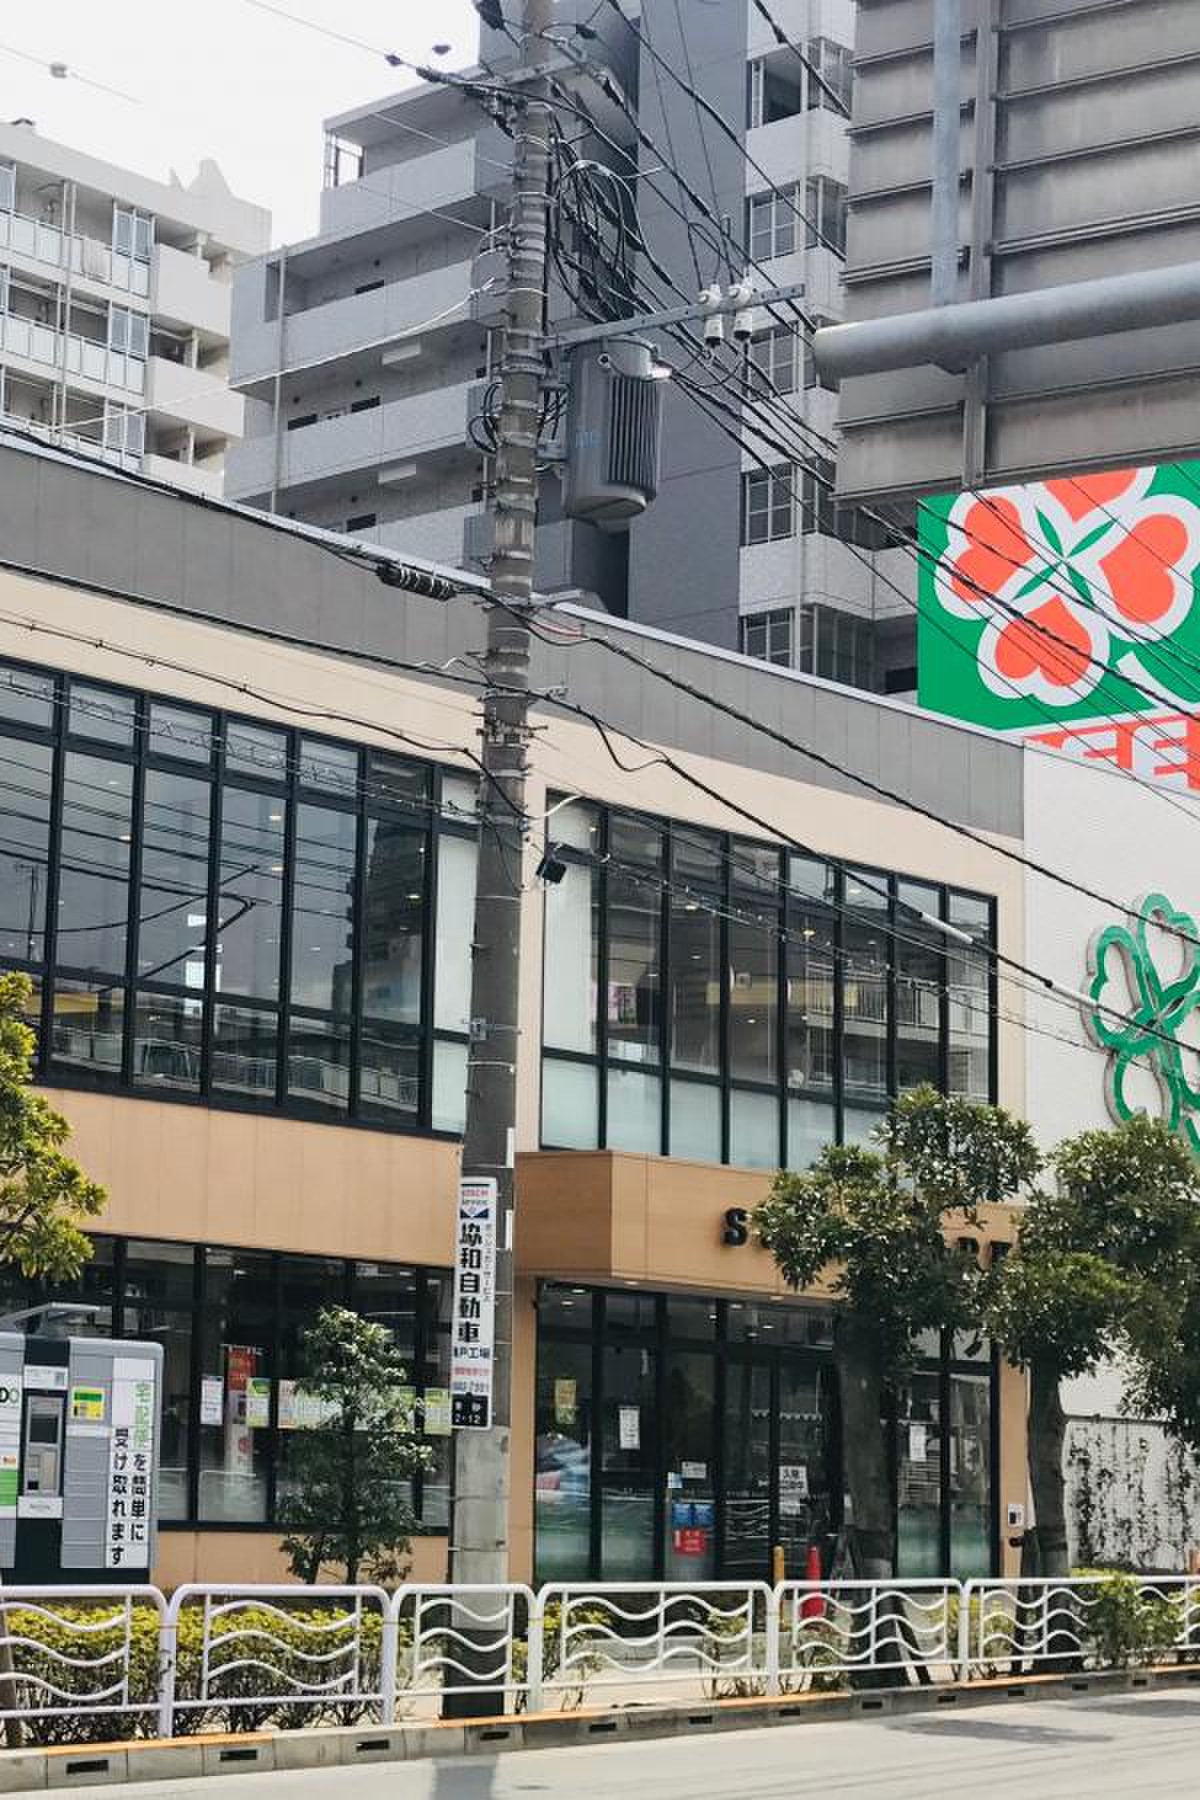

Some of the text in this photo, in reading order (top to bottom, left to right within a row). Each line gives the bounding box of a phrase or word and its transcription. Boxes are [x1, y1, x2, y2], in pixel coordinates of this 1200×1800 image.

[459, 1223, 482, 1343] 協和自動車
[111, 1428, 128, 1565] 受け取れます
